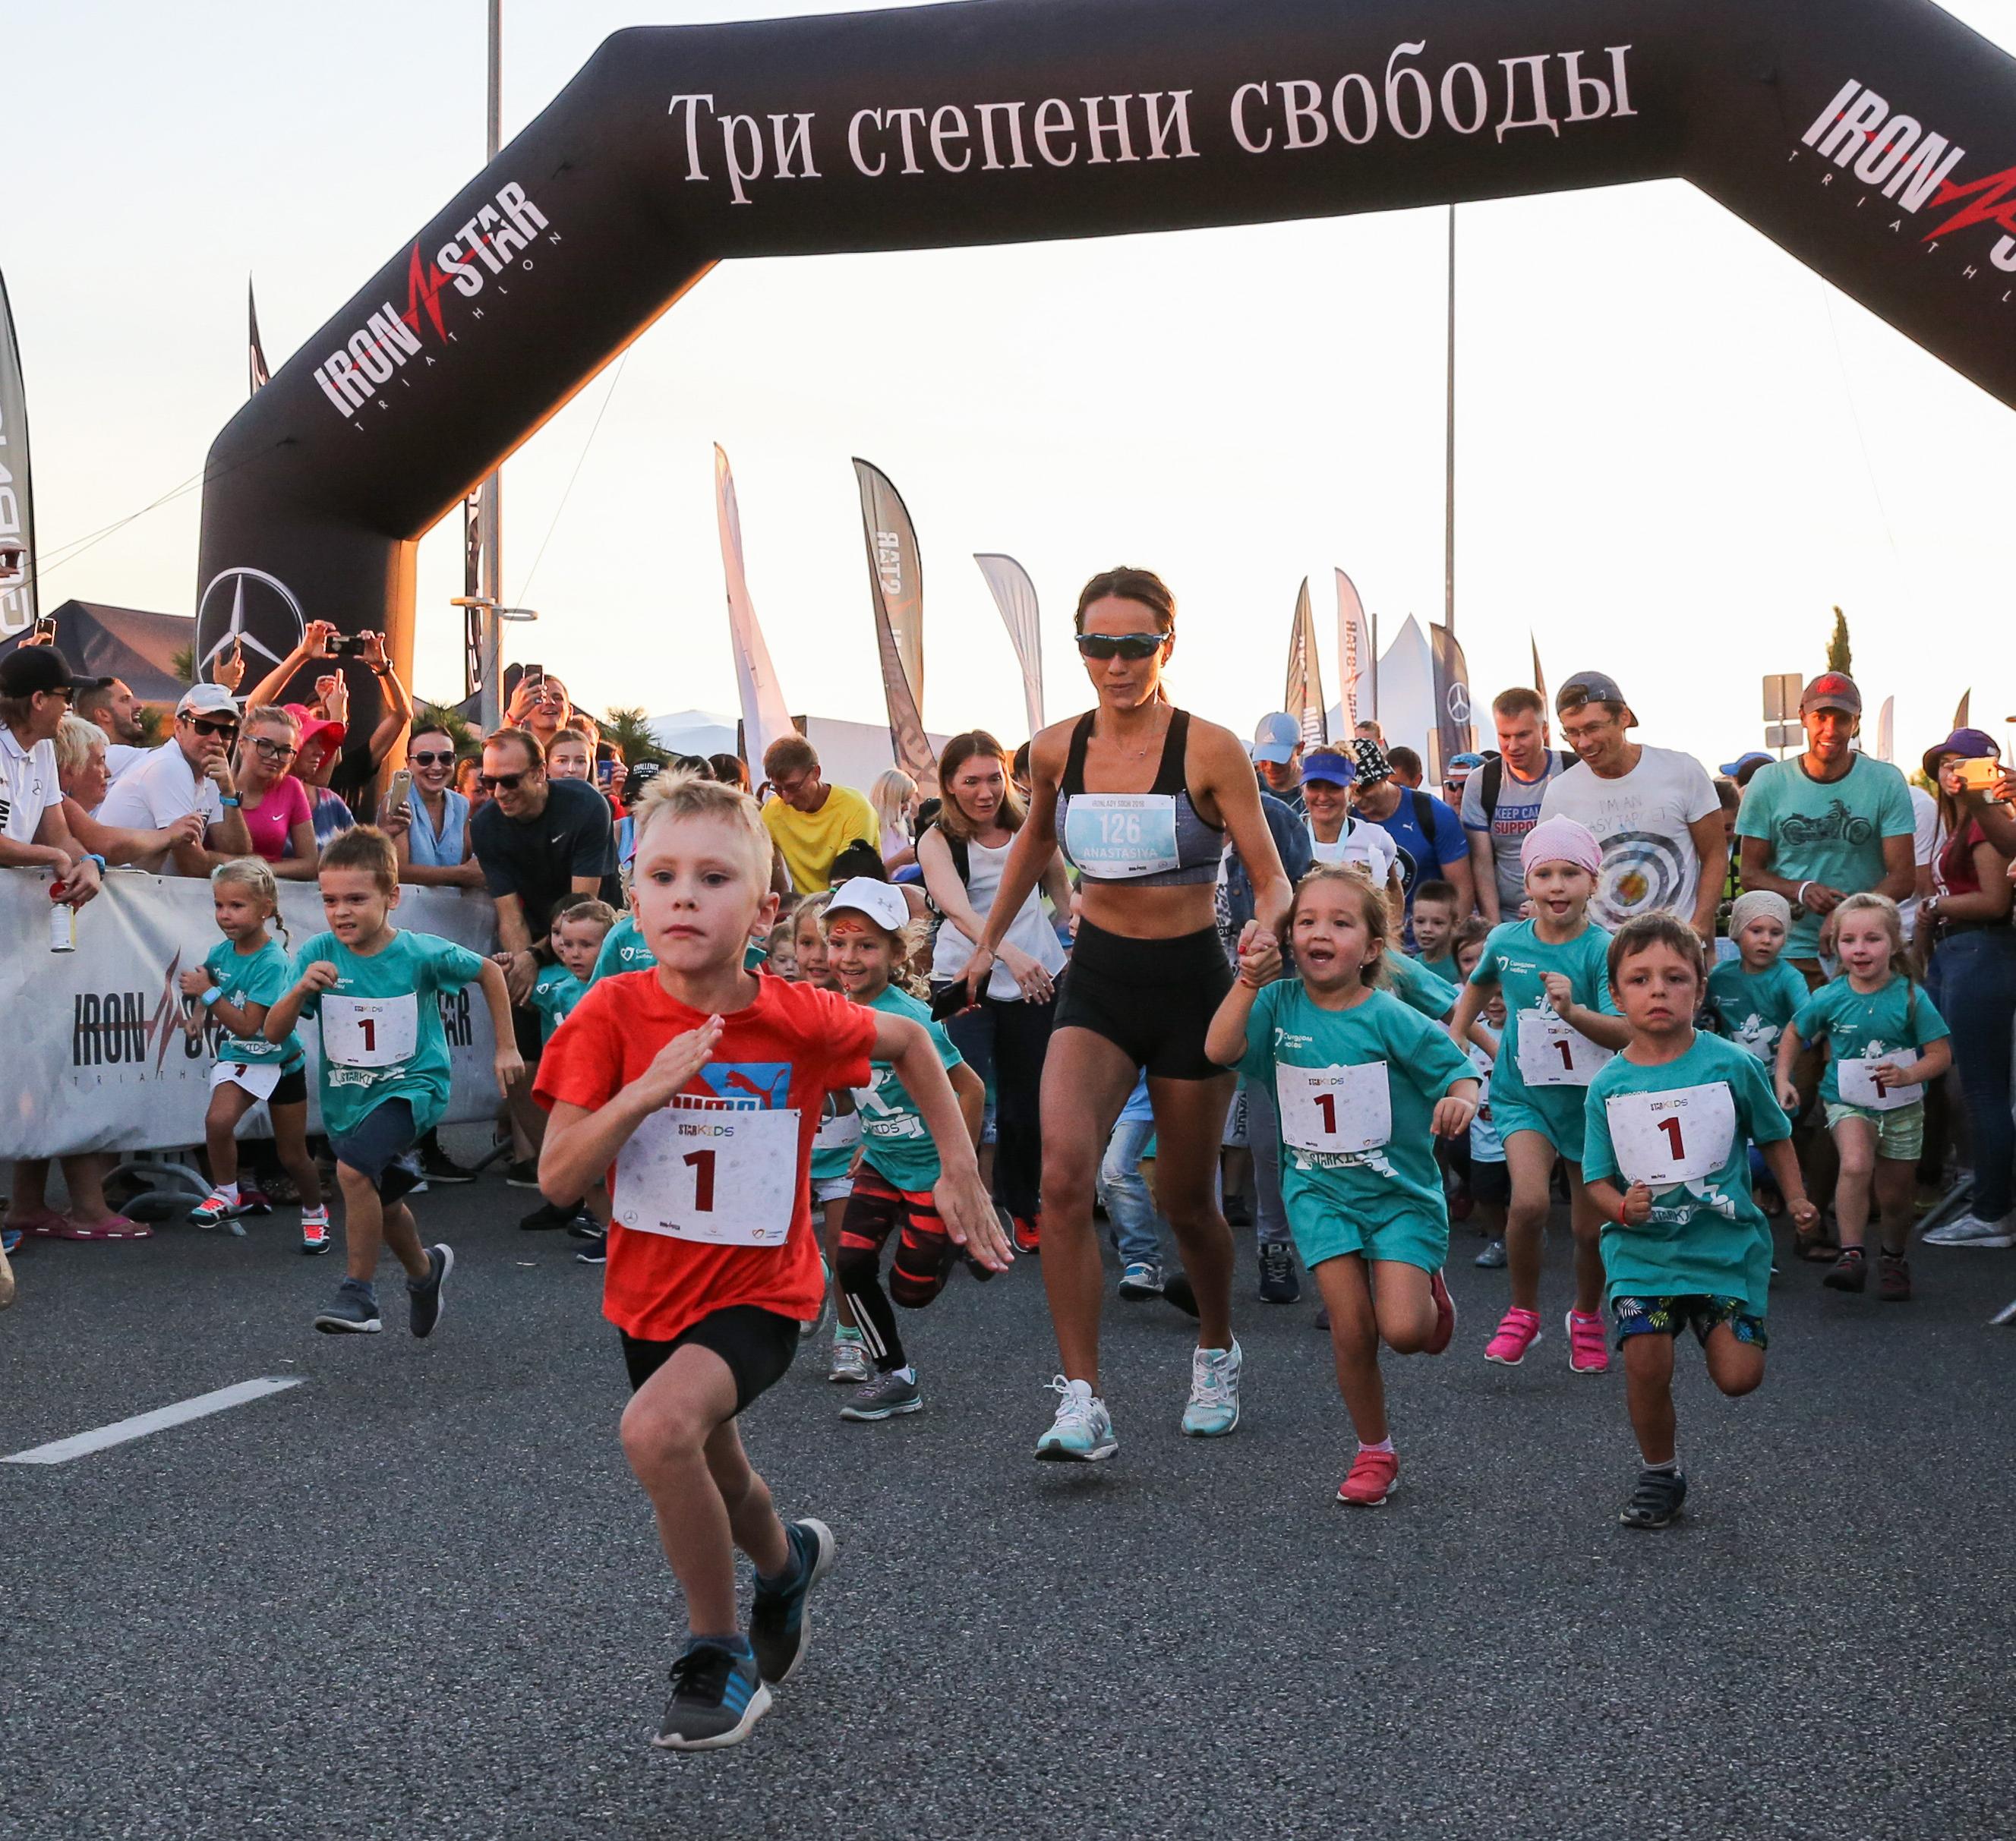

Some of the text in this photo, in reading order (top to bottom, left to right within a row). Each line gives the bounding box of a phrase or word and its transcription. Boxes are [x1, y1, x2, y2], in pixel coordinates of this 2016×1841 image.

[668, 39, 1638, 204] Три степени свободы
[1801, 78, 1966, 214] IRON
[1788, 150, 2011, 303] TRIATHL
[313, 181, 550, 418] IRON STAR
[355, 232, 562, 432] TRIATHLON
[1100, 813, 1141, 844] 126
[1494, 820, 1537, 834] SUPPO
[1495, 805, 1539, 819] KEEP CAL
[73, 991, 146, 1066] IRON
[358, 1018, 375, 1051] 1
[74, 1068, 206, 1086] TRIATHL
[1553, 1039, 1574, 1070] 1
[1313, 1093, 1336, 1134] 1
[1657, 1116, 1685, 1161] 1
[683, 1149, 716, 1212] 1
